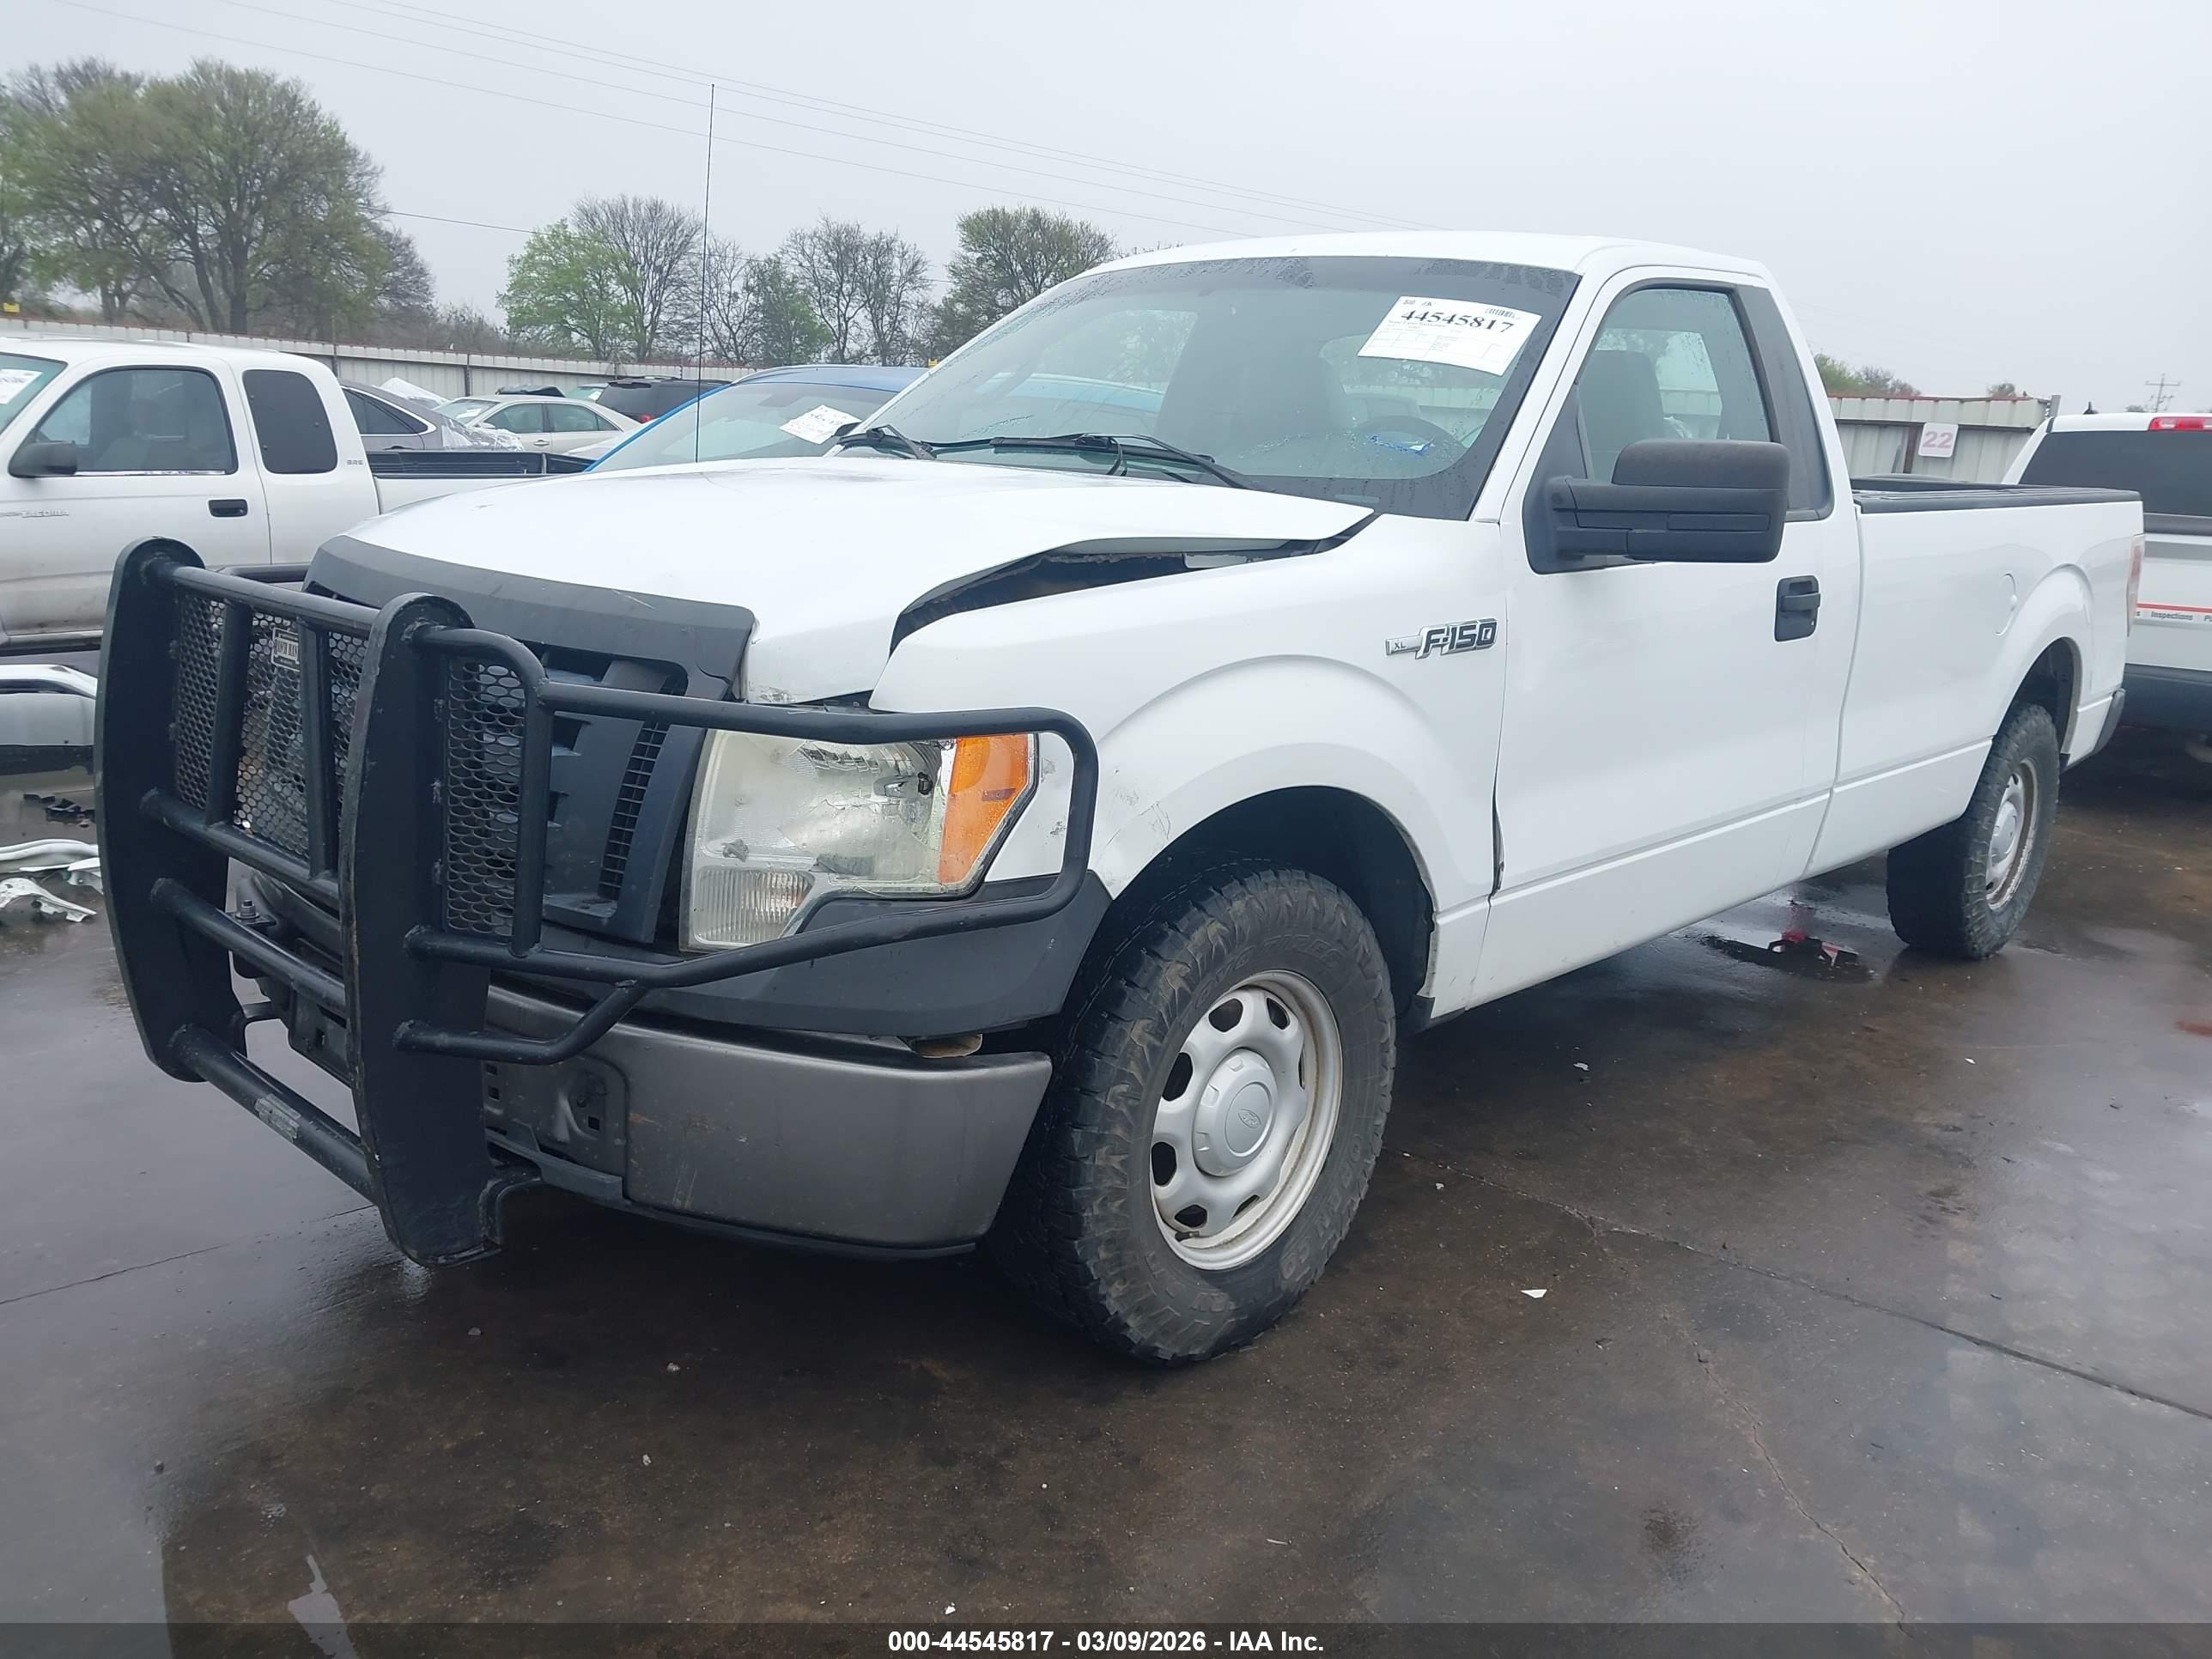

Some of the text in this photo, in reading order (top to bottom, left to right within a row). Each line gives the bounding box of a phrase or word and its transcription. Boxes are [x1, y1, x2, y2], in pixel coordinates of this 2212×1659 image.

[1401, 310, 1514, 333] 44545817
[1923, 432, 1953, 448] 22
[1418, 620, 1497, 657] F-150
